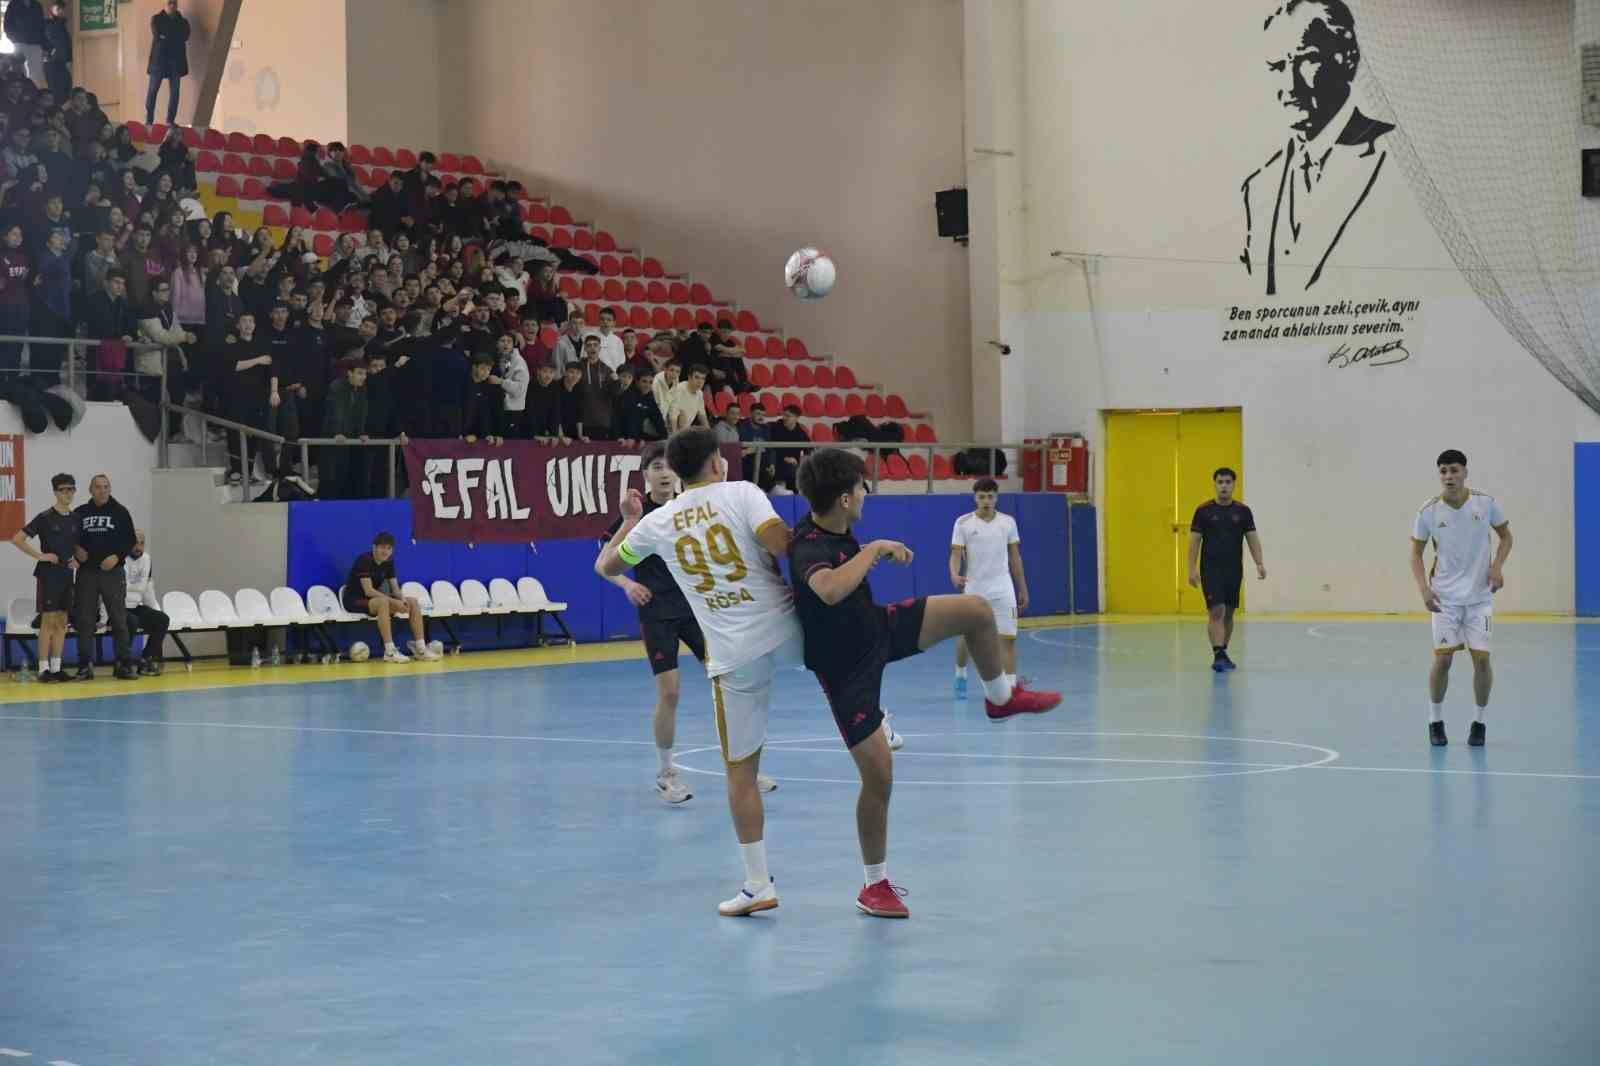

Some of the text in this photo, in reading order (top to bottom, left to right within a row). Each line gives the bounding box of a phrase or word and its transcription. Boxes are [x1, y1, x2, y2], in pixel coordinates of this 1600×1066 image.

[1229, 305, 1251, 320] Ben
[1255, 304, 1320, 322] sporcunun
[1222, 324, 1279, 341] zamanda
[1282, 320, 1349, 337] ahlaklısını
[422, 459, 531, 519] EFAL
[673, 500, 719, 531] EFAL
[675, 522, 748, 593] 99
